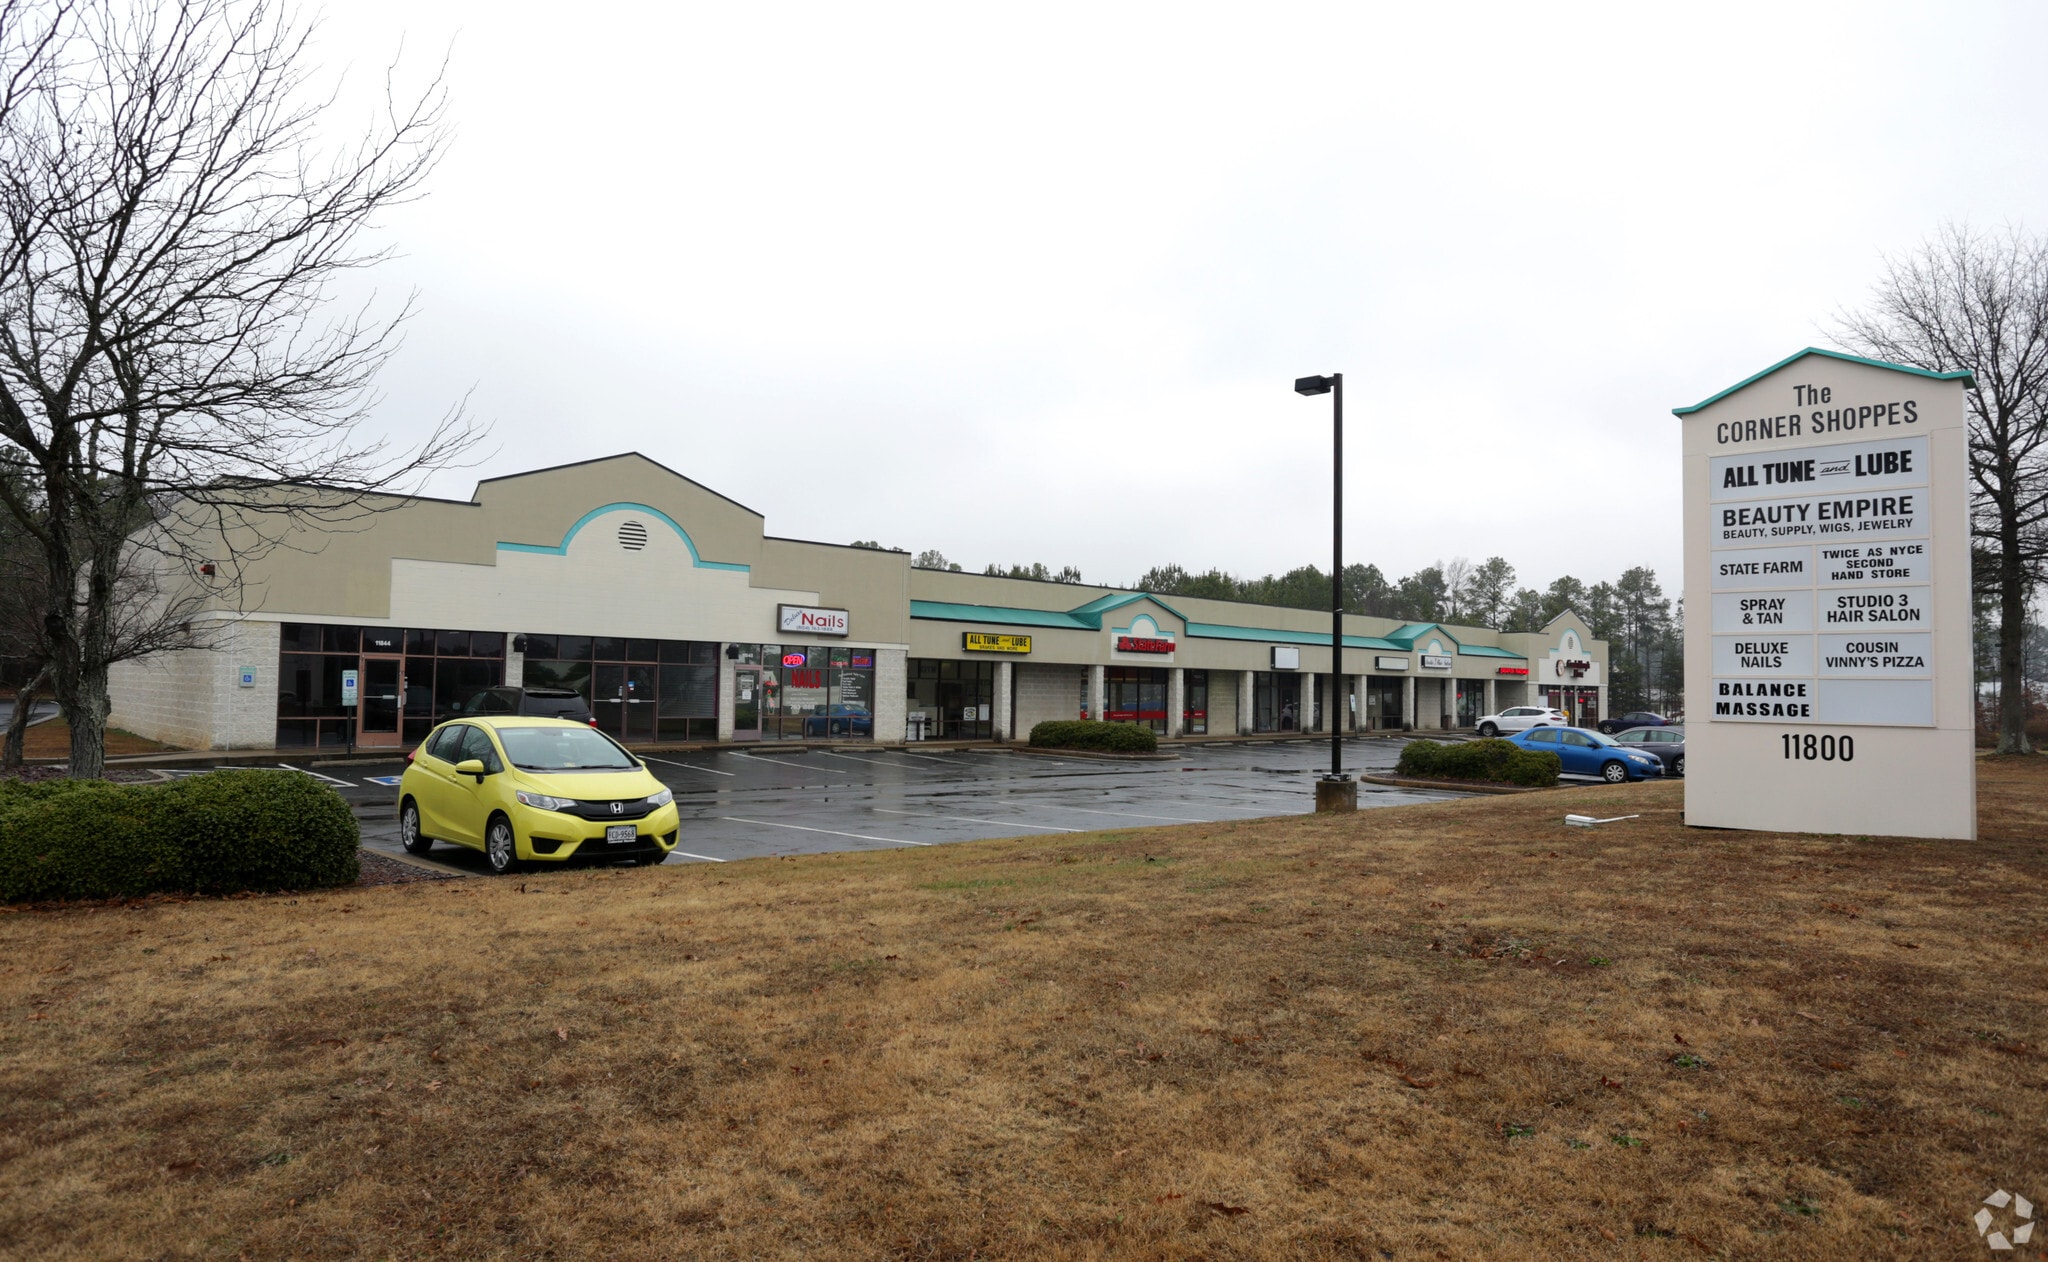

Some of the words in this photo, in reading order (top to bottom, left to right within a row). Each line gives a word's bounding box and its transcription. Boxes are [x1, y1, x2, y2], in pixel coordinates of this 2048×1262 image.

[1793, 384, 1831, 406] The
[1718, 415, 1800, 444] CORNER
[1811, 400, 1918, 433] SHOPPES
[1724, 466, 1758, 488] ALL
[1763, 460, 1815, 484] TUNE
[1820, 462, 1850, 475] and
[1855, 450, 1912, 477] LUBE
[1723, 504, 1810, 527] BEAUTY
[1819, 496, 1913, 521] EMPIRE
[1723, 528, 1768, 540] BEAUTY,
[1771, 525, 1815, 537] SUPPLY,
[1819, 523, 1854, 533] WIGS,
[1858, 518, 1912, 531] JEWELRY
[1823, 549, 1859, 559] TWICE
[1867, 548, 1882, 556] AS
[1890, 545, 1923, 555] NYCE
[1720, 563, 1759, 575] STATE
[1764, 561, 1802, 573] FARM
[1846, 558, 1893, 569] SECOND
[1832, 571, 1863, 580] HAND
[1871, 569, 1910, 579] STORE
[1741, 599, 1785, 611] SPRAY
[1837, 596, 1894, 609] STUDIO
[1899, 594, 1908, 606] 3
[801, 612, 844, 628] Nails
[1743, 613, 1753, 624] &
[1757, 613, 1782, 624] TAN
[1828, 610, 1863, 622] HAIR
[1869, 609, 1919, 621] SALON
[970, 635, 981, 644] ALL
[983, 635, 999, 645] TUNE
[1012, 637, 1027, 647] LUBE
[1735, 642, 1788, 654] DELUXE
[1846, 642, 1898, 653] COUSIN
[783, 655, 804, 666] OPEN
[1741, 656, 1781, 667] NAILS
[1826, 657, 1878, 667] VINNY'S
[1883, 657, 1924, 667] PIZZA
[791, 670, 822, 689] NAILS
[1719, 683, 1806, 697] BALANCE
[1716, 702, 1809, 717] MASSAGE
[1782, 734, 1853, 761] 11800
